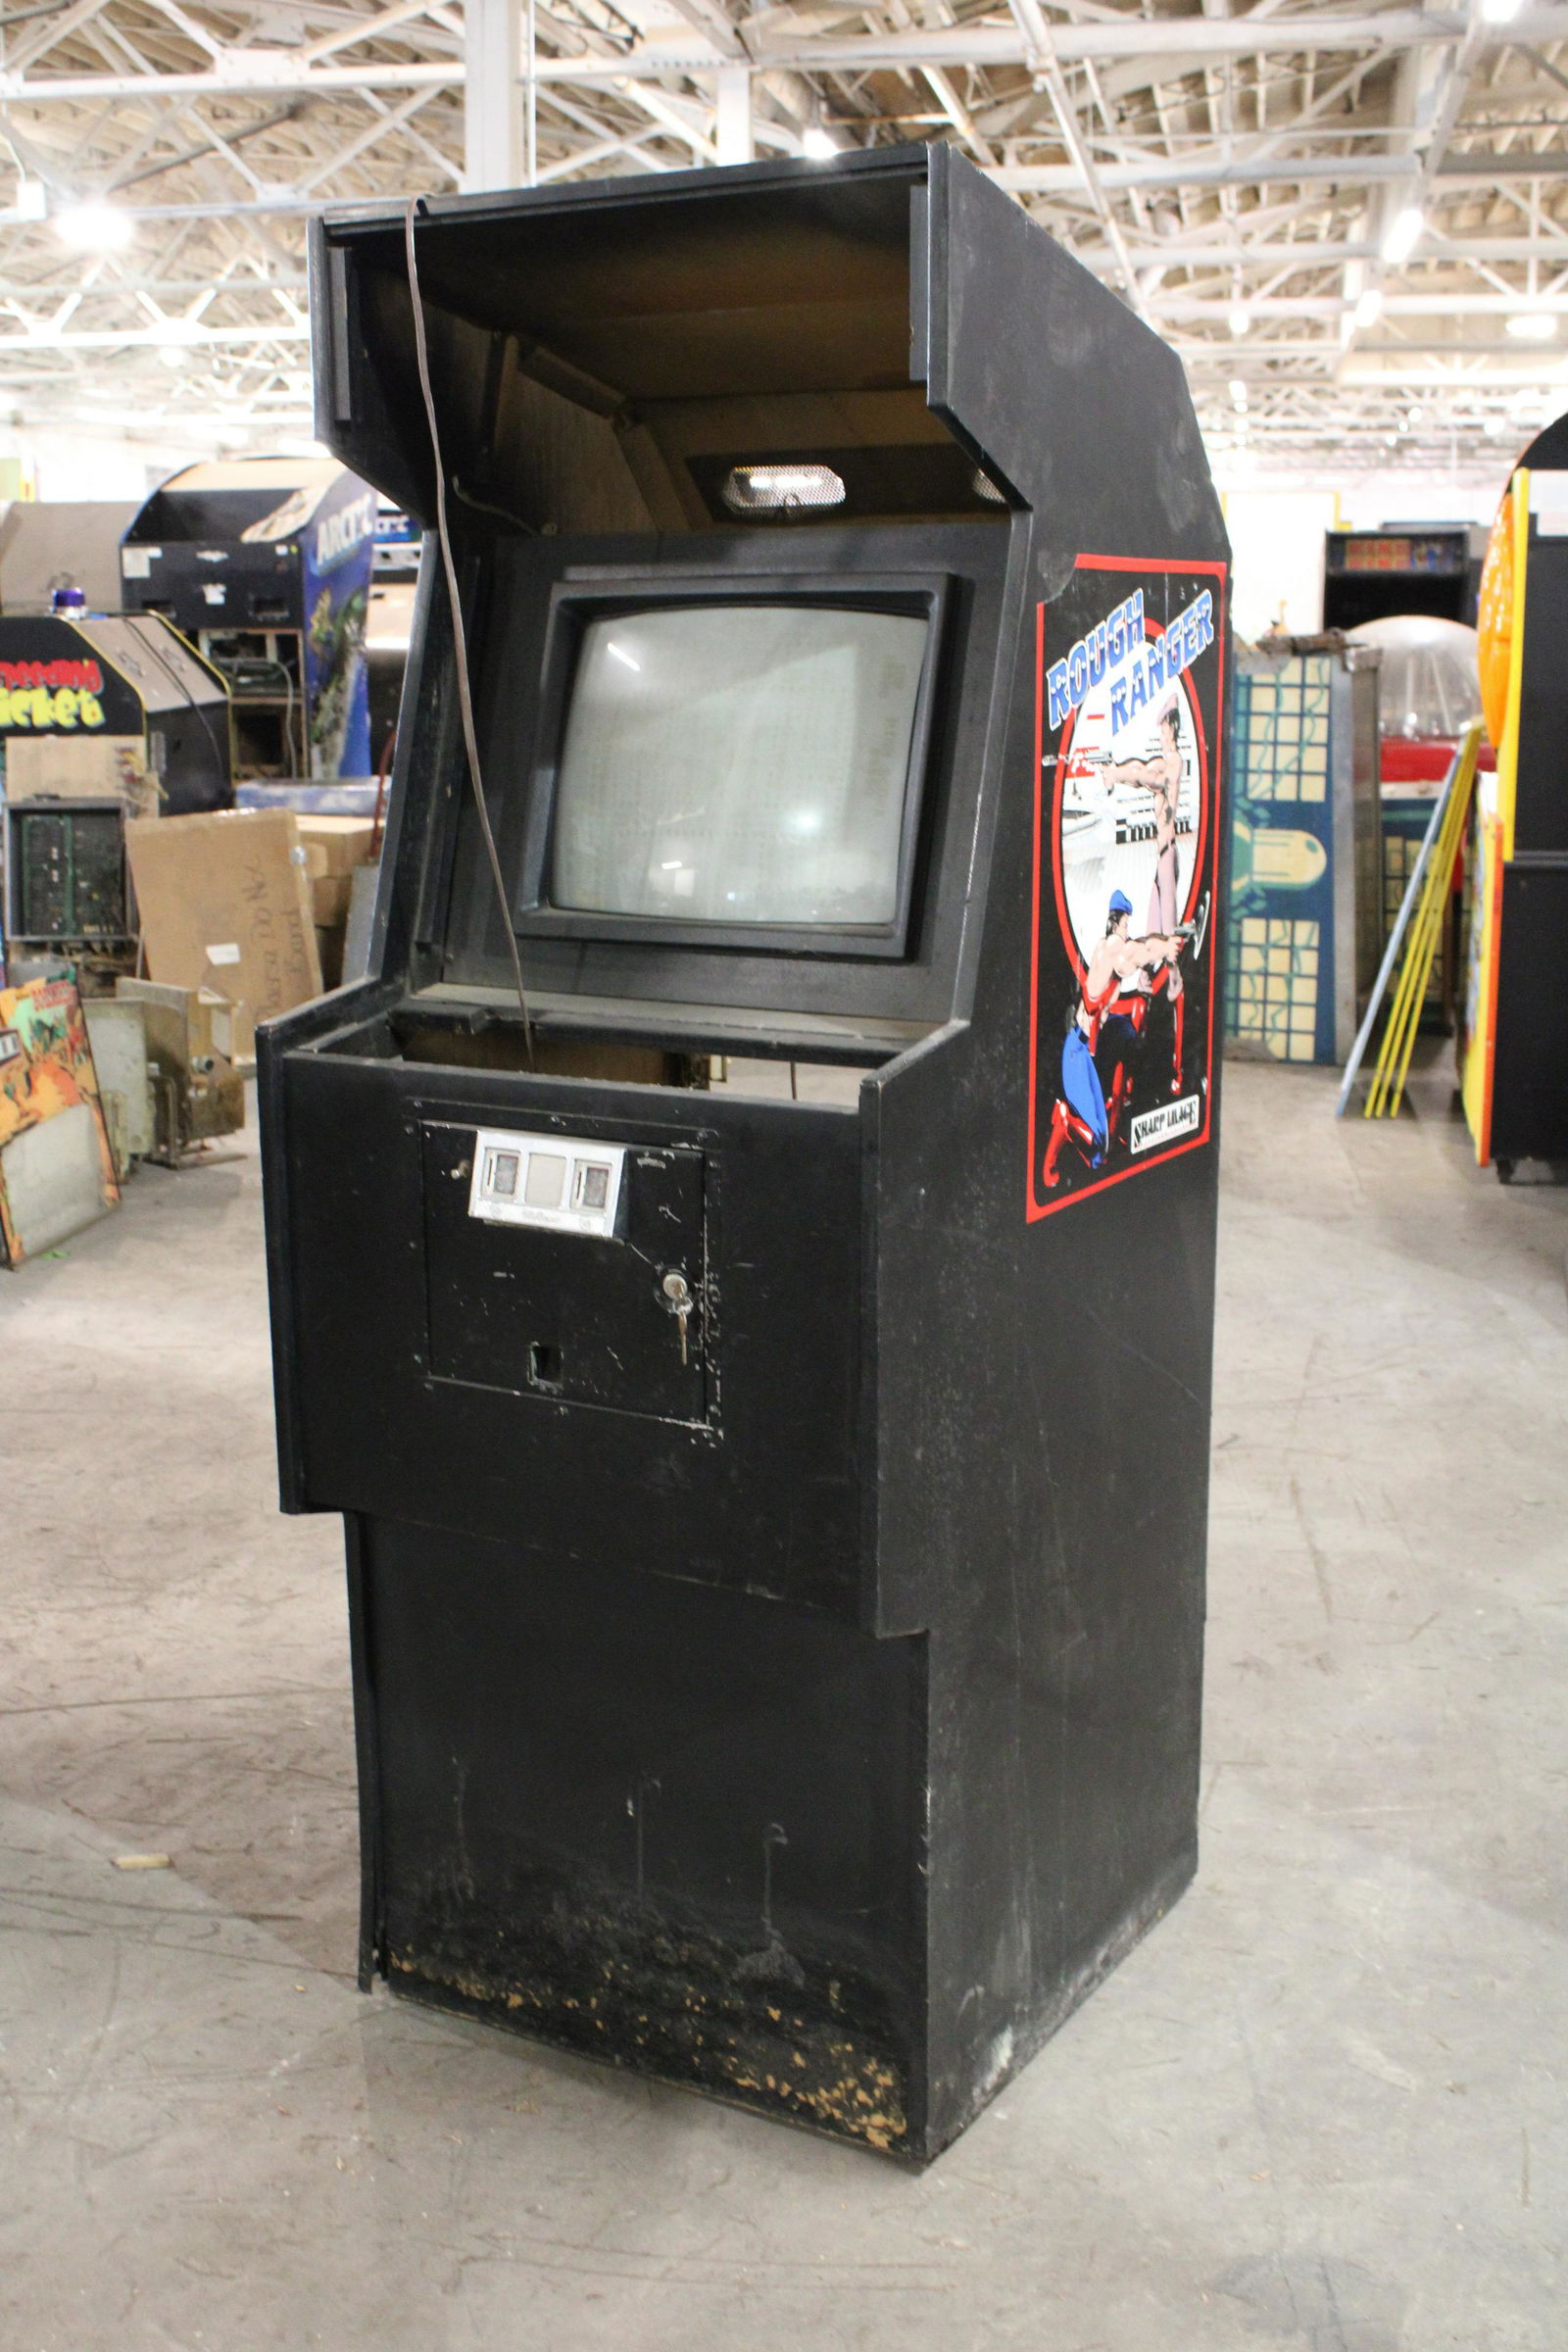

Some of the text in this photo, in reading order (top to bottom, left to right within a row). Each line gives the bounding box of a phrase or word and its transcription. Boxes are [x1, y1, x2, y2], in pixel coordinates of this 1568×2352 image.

[1046, 588, 1145, 731] ROUGH
[1109, 589, 1214, 736] RANGER
[1134, 1112, 1166, 1149] SHARP
